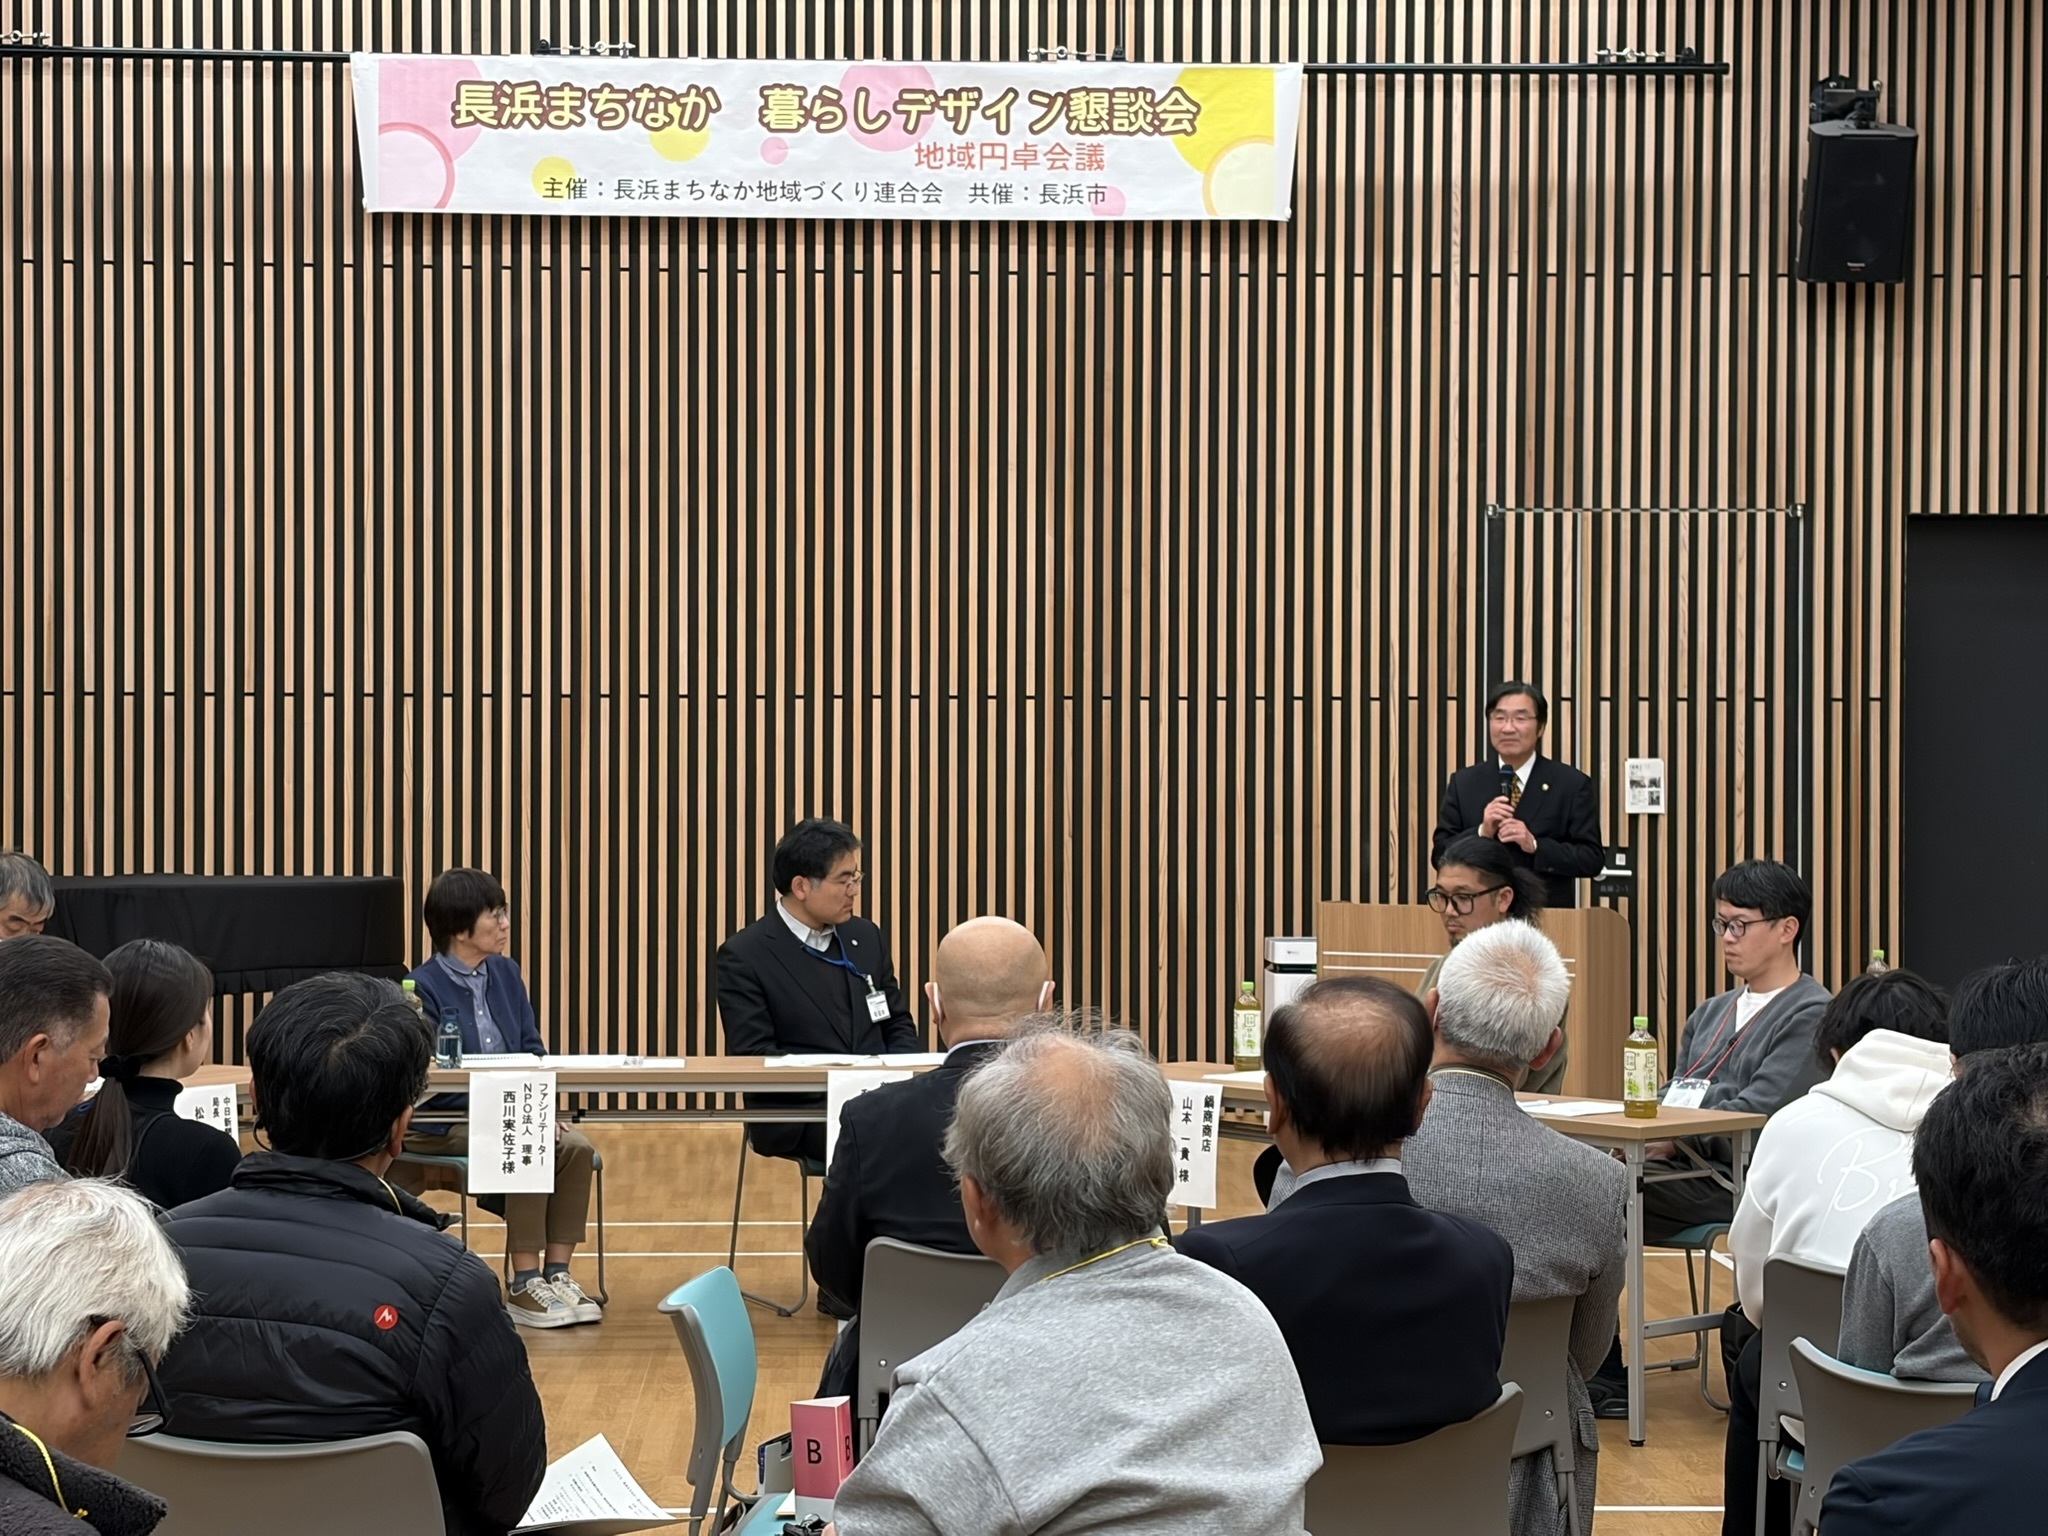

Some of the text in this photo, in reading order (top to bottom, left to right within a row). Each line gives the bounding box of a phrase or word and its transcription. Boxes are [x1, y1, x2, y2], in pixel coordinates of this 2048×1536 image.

[451, 79, 1201, 136] 長浜まちなか 暮らしデザイン懇談会
[914, 142, 1106, 171] 地域円卓会議
[502, 1091, 516, 1174] 西川実佐子様
[538, 1082, 548, 1166] ファシリテーター
[806, 1438, 822, 1465] B
[844, 1435, 851, 1462] B
